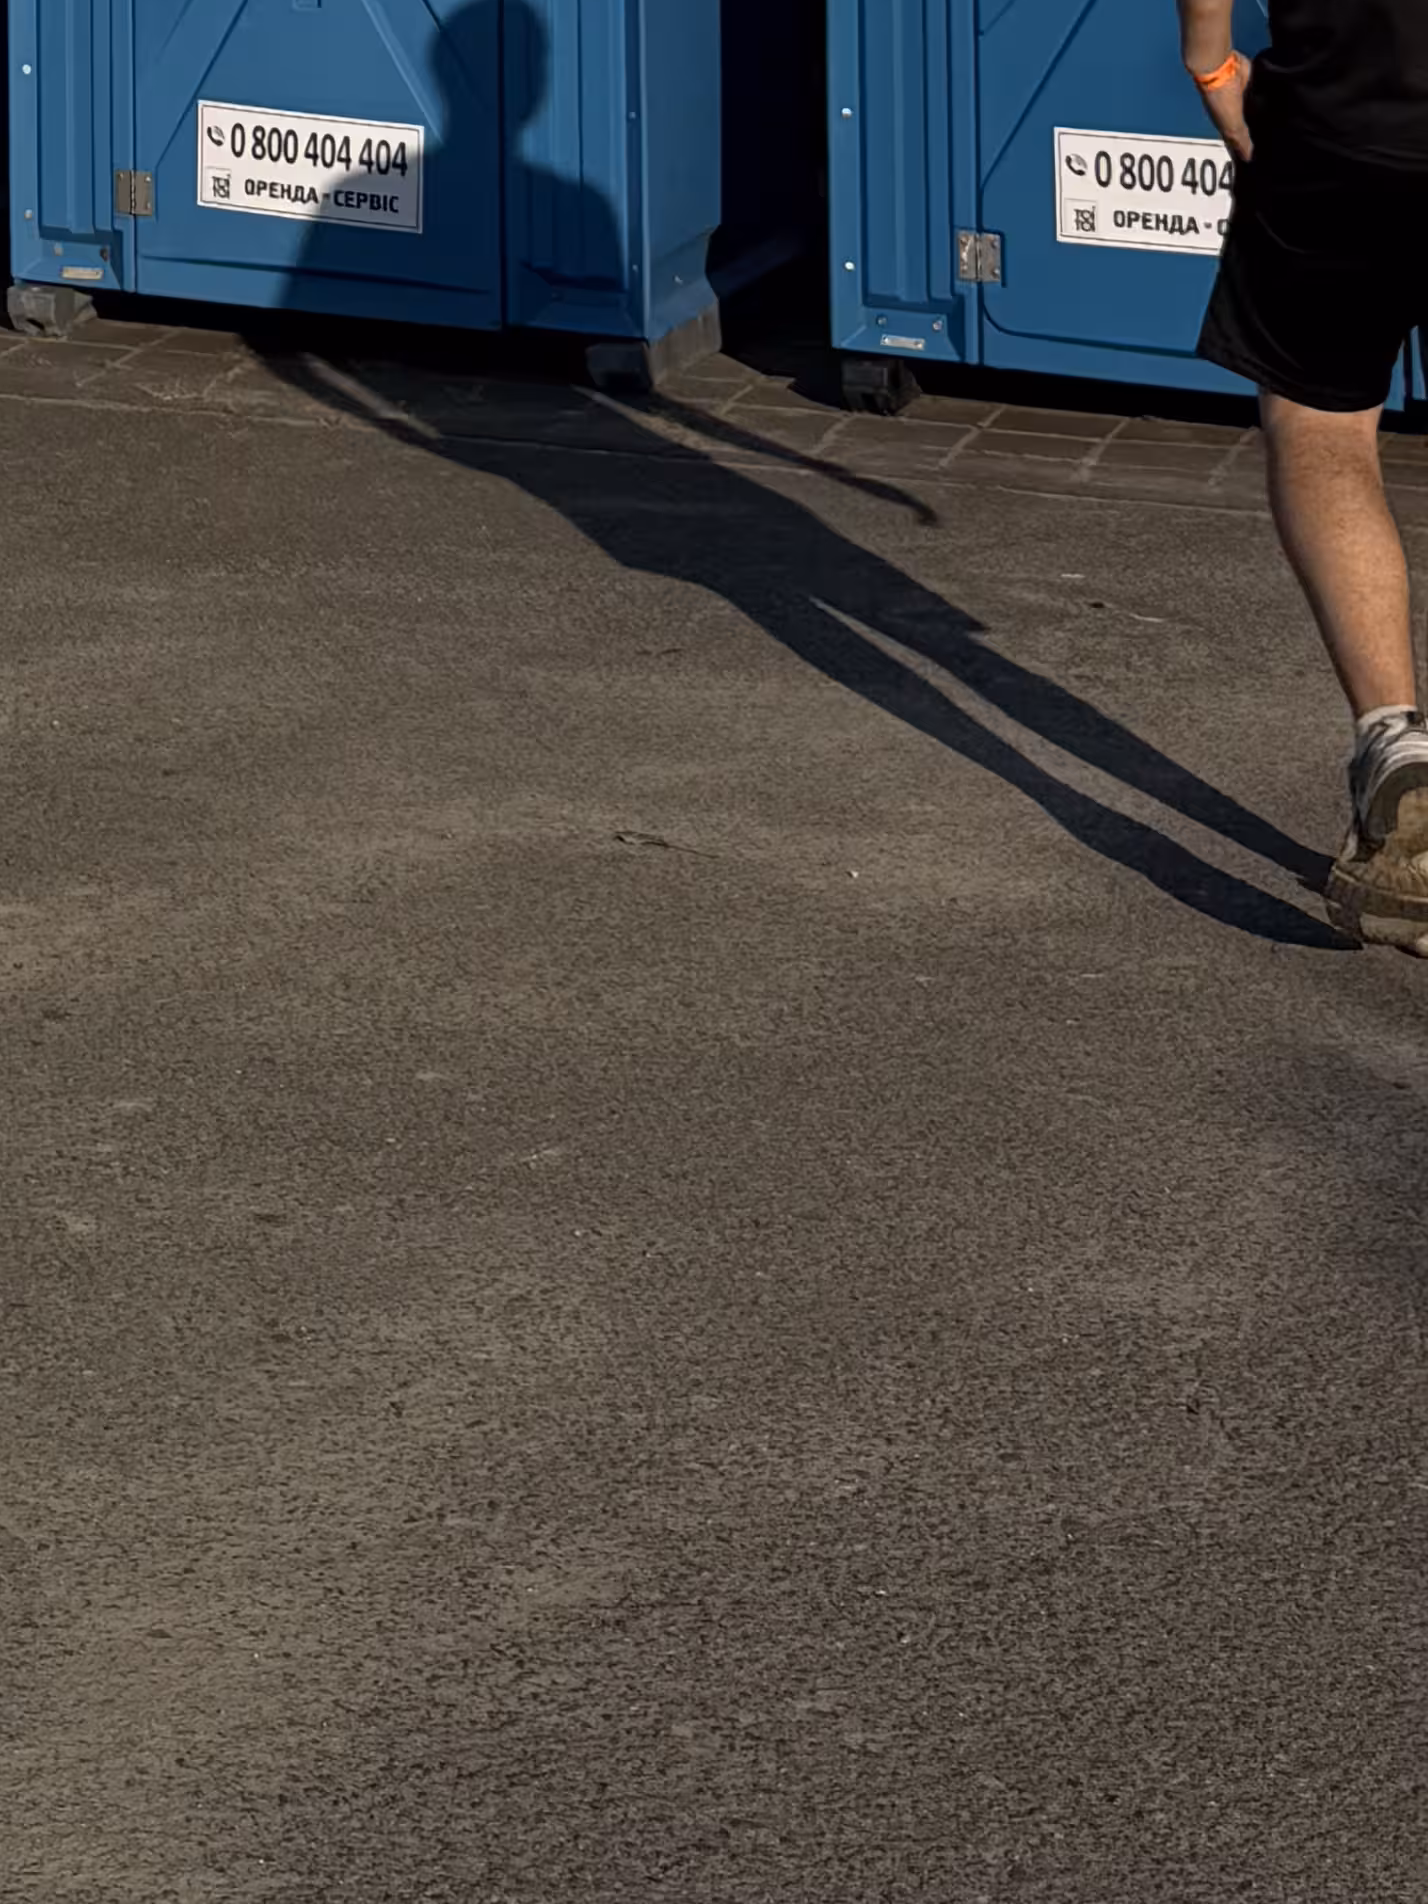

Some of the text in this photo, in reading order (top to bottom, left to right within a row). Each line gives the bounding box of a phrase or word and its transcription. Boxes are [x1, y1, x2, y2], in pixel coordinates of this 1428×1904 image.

[231, 123, 408, 178] 0 800 404 404
[1095, 150, 1112, 188] 0
[1119, 152, 1174, 193] 800
[244, 178, 319, 205] ОРЕНДА
[333, 189, 399, 214] СЕРВІС
[1113, 209, 1200, 236] ОРЕНДА
